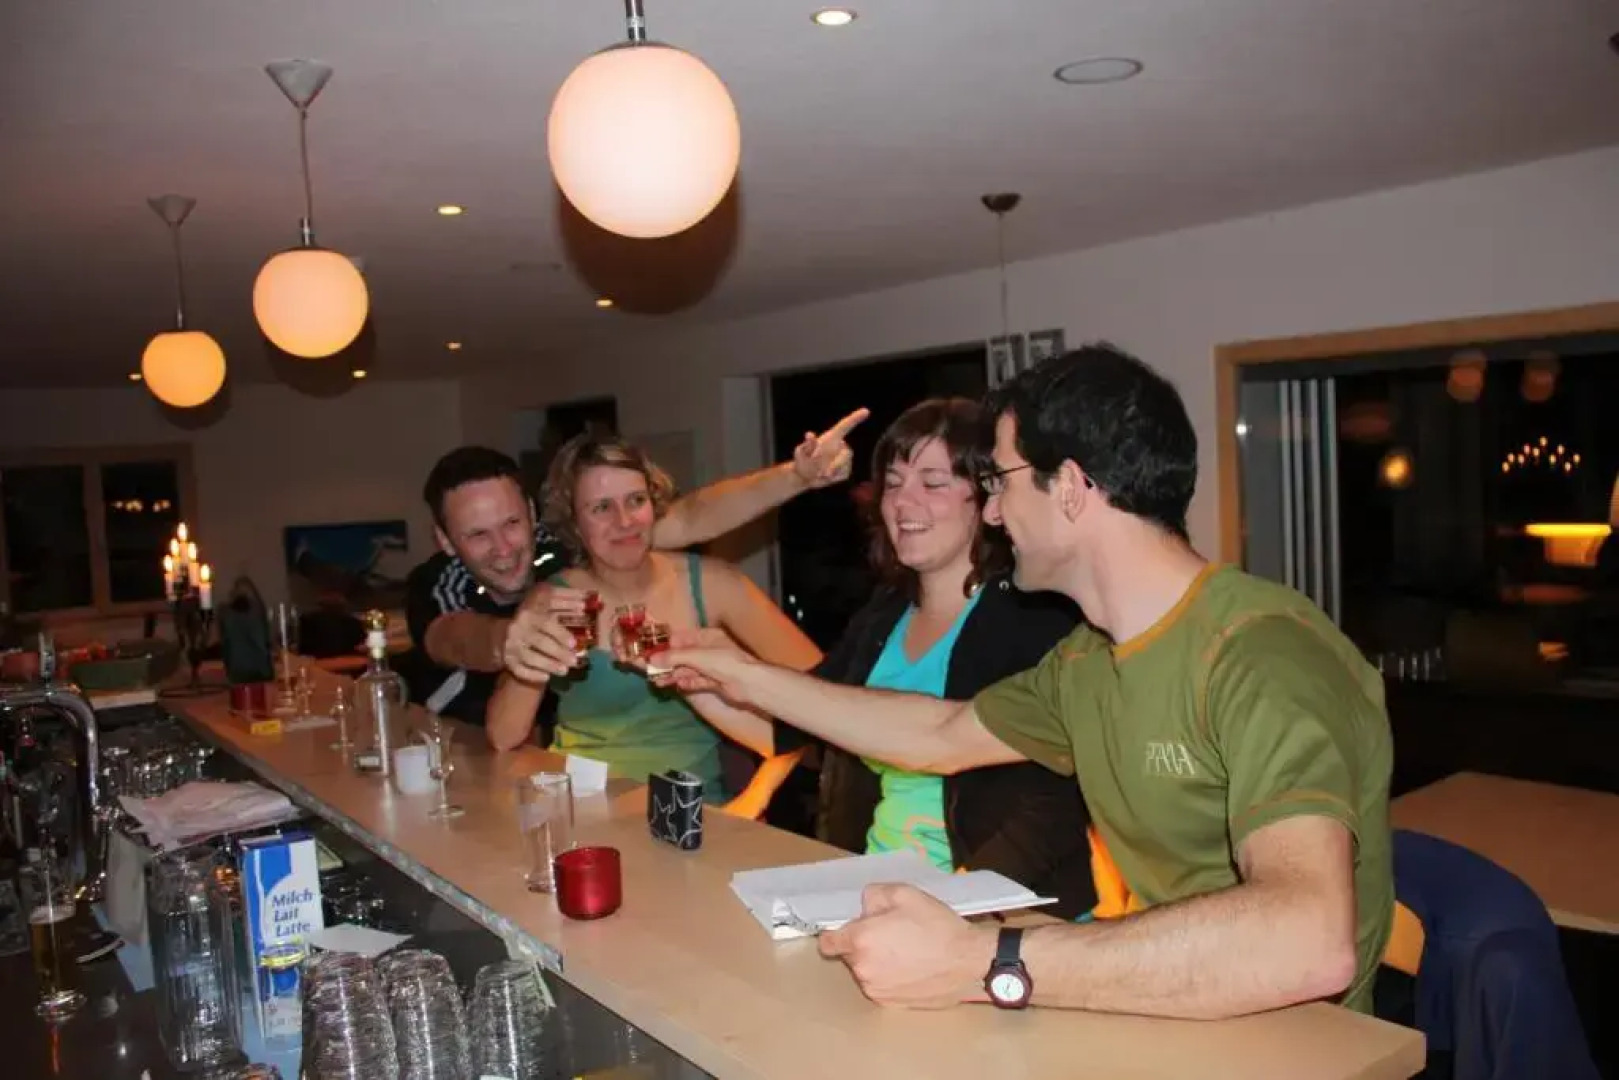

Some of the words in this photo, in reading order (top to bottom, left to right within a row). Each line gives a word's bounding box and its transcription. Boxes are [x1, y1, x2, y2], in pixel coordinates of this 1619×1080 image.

[272, 889, 313, 907] Milch
[274, 907, 298, 922] Lait
[276, 921, 311, 937] Latte
